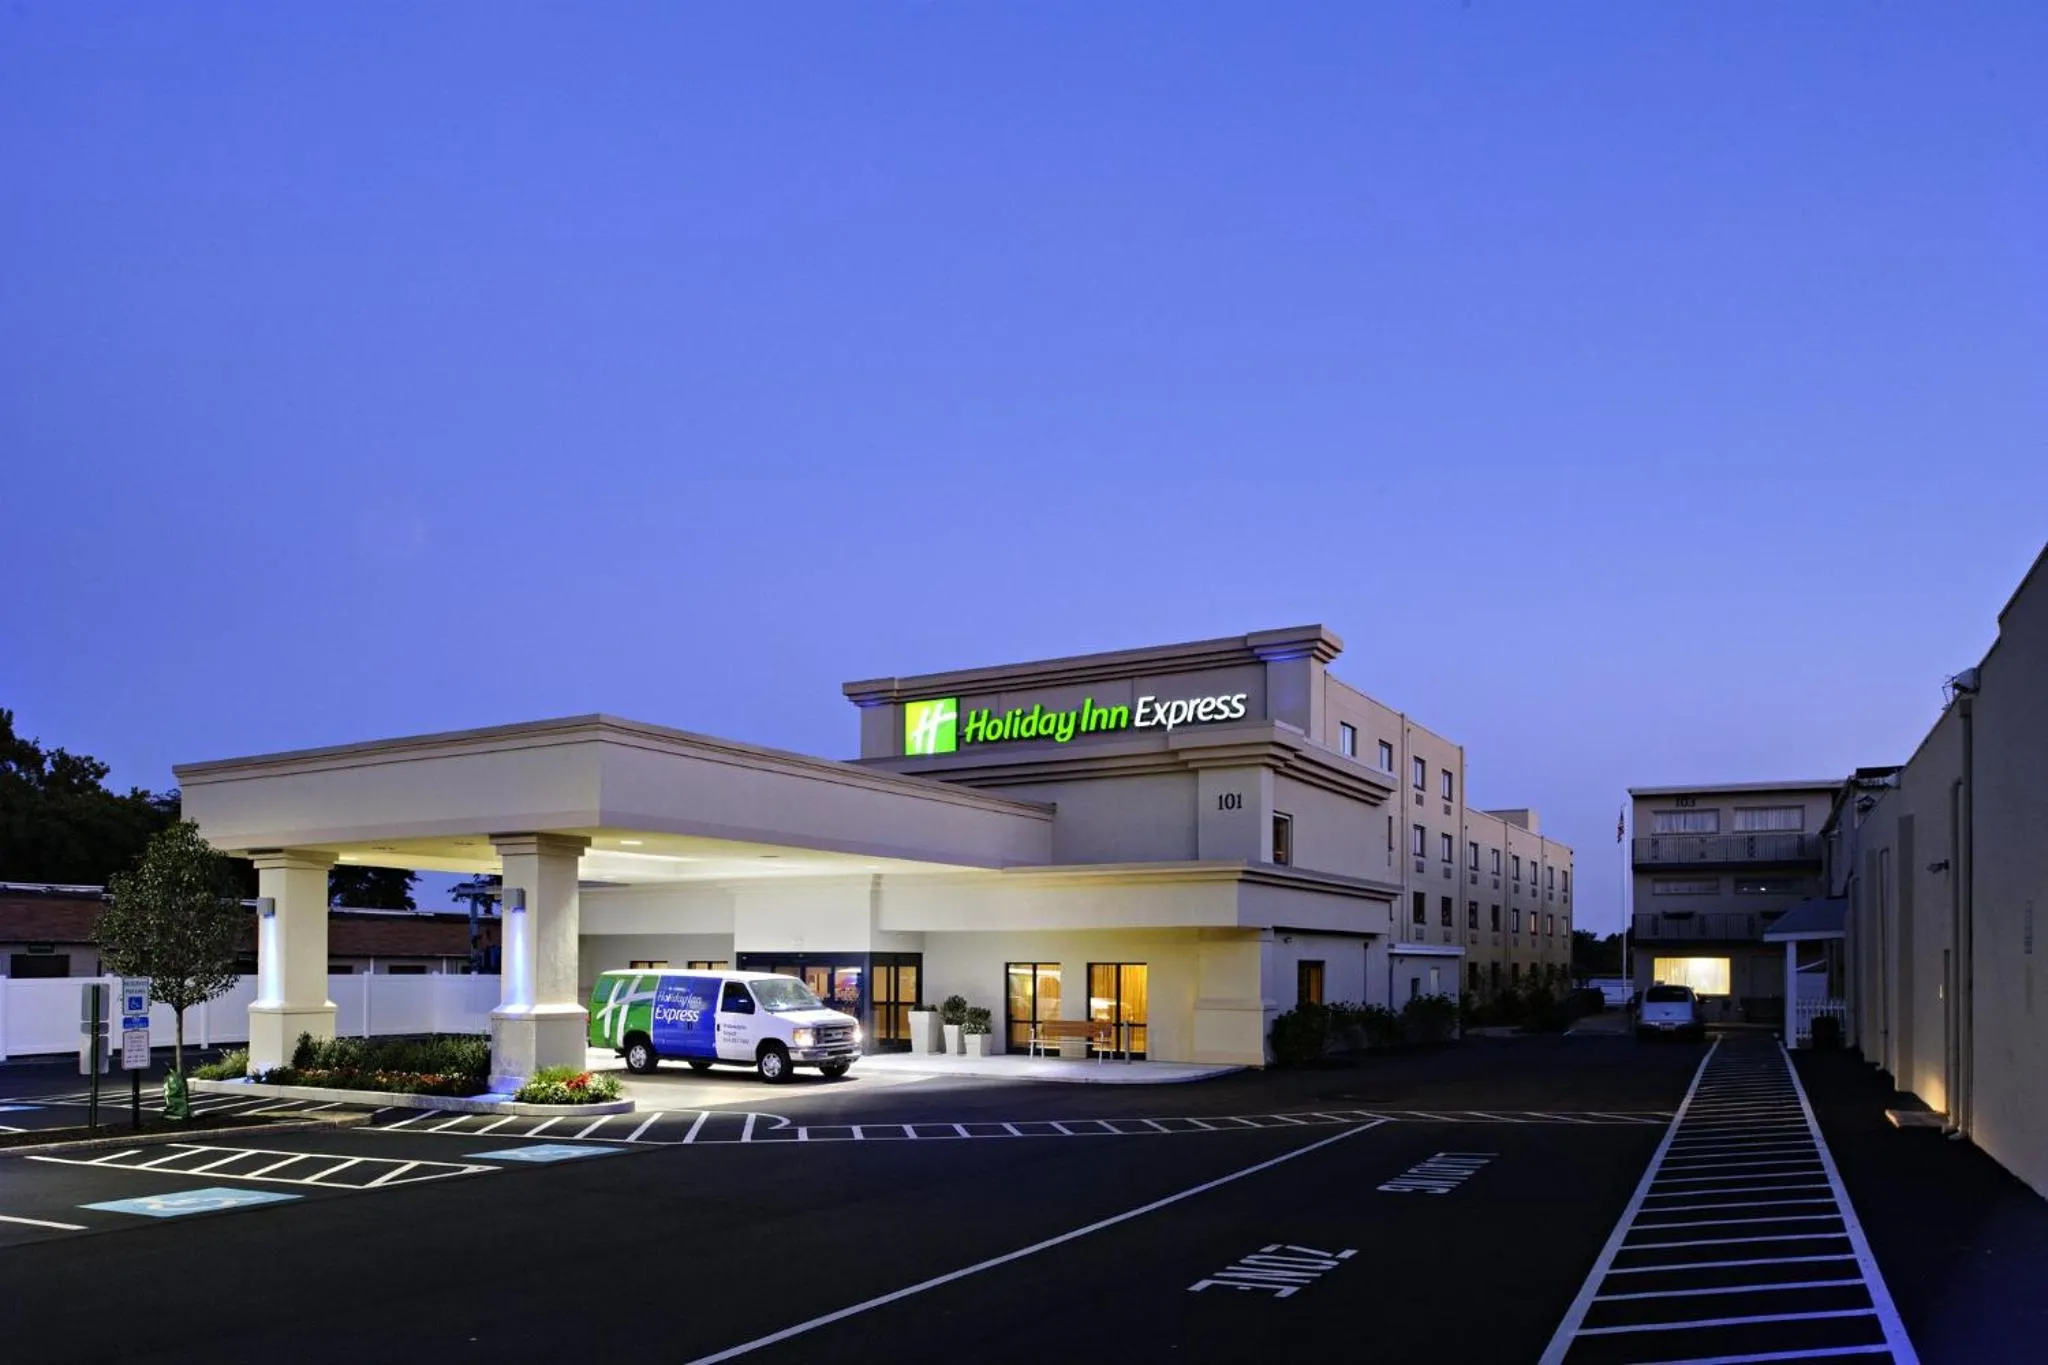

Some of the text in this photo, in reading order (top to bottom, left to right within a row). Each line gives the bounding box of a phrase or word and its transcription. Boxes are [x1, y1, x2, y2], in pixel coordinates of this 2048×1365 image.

[964, 693, 1247, 743] Holiday Inn Express
[1217, 792, 1243, 810] 101
[655, 1004, 700, 1025] Express
[1186, 1243, 1359, 1298] ZONE
